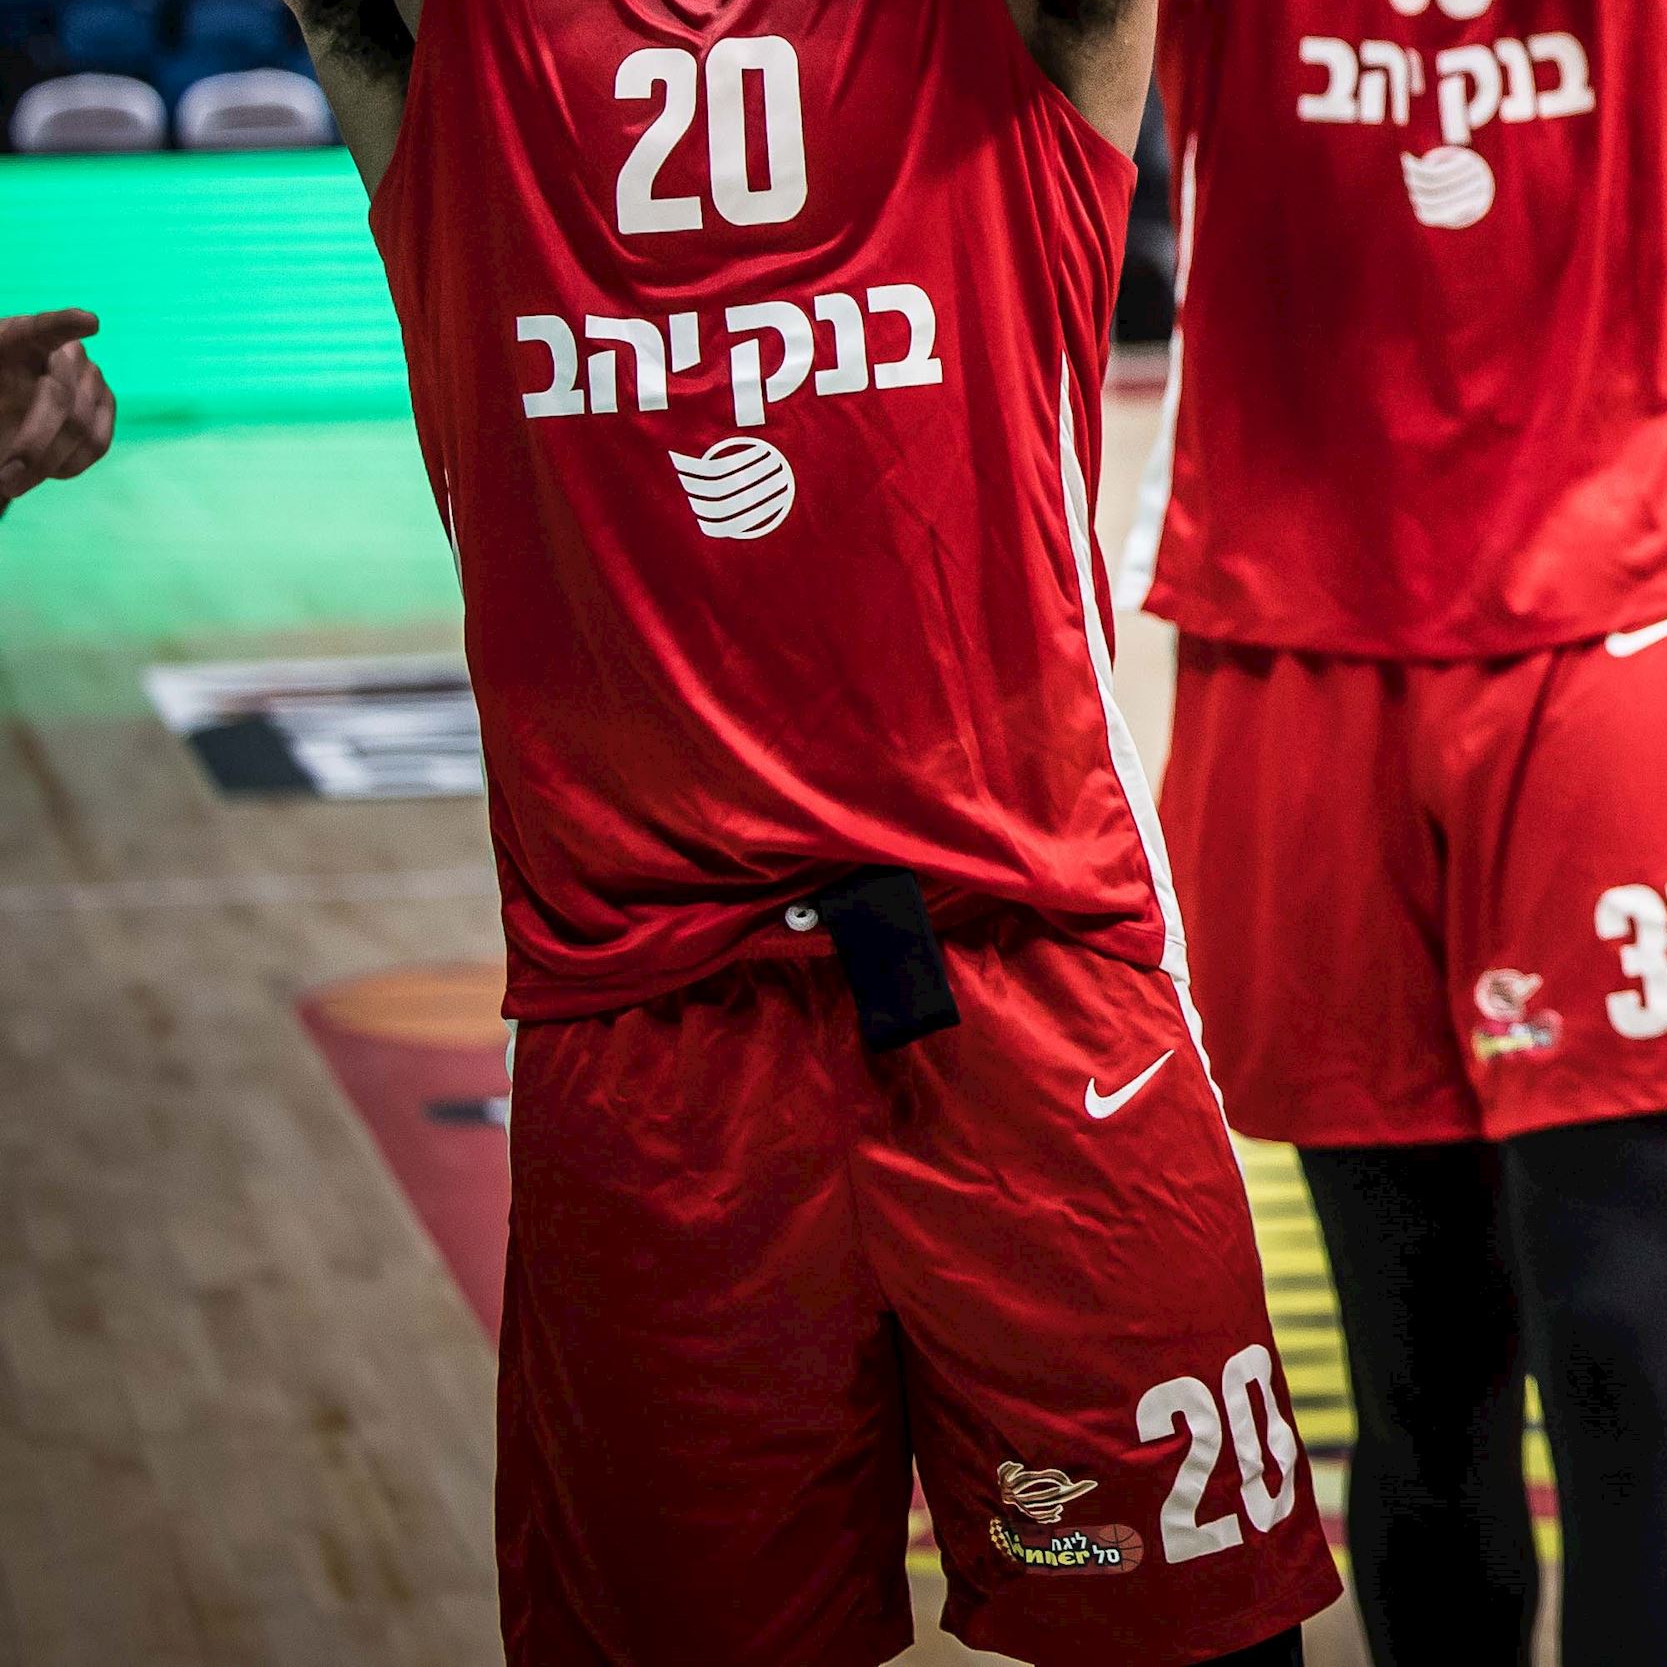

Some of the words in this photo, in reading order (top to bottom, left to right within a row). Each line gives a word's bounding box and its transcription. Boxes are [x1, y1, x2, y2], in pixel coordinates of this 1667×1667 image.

[613, 34, 808, 234] 20
[1297, 36, 1425, 125] יהב
[1436, 31, 1596, 145] בנק
[515, 311, 702, 419] יהב
[724, 283, 944, 427] בנק
[1135, 1343, 1299, 1566] 20
